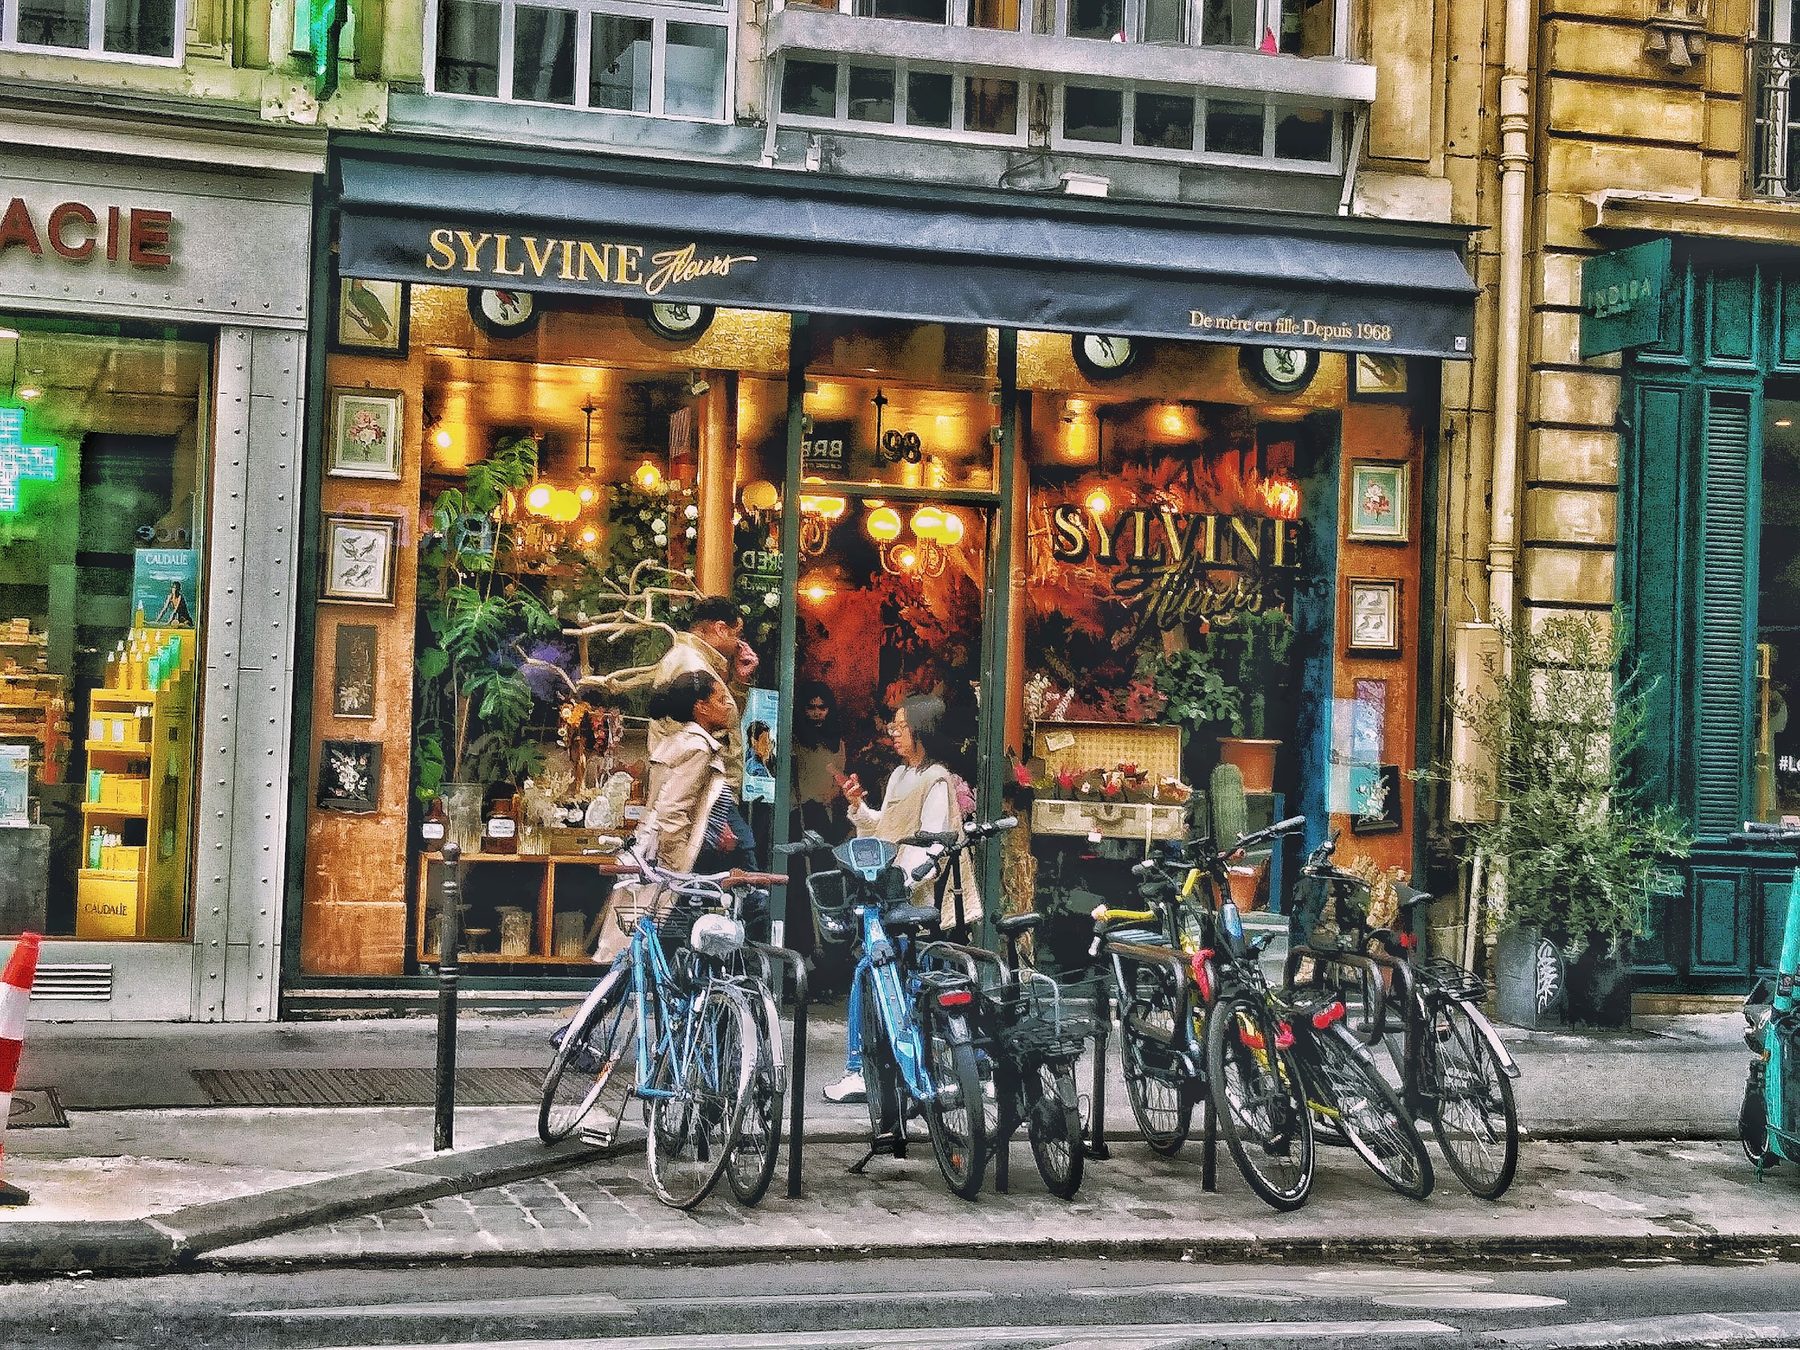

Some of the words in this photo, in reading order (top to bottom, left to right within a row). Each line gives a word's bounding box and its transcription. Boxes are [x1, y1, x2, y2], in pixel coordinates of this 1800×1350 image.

[425, 227, 644, 286] SYLVINE
[645, 242, 758, 296] Fleurs
[1189, 310, 1213, 329] De
[1215, 313, 1252, 331] mère
[1254, 319, 1272, 333] en
[1275, 316, 1301, 335] fille
[1303, 319, 1353, 341] Depuis
[1356, 323, 1392, 342] 1968
[881, 429, 922, 464] 98
[1054, 502, 1304, 568] SYLVINE
